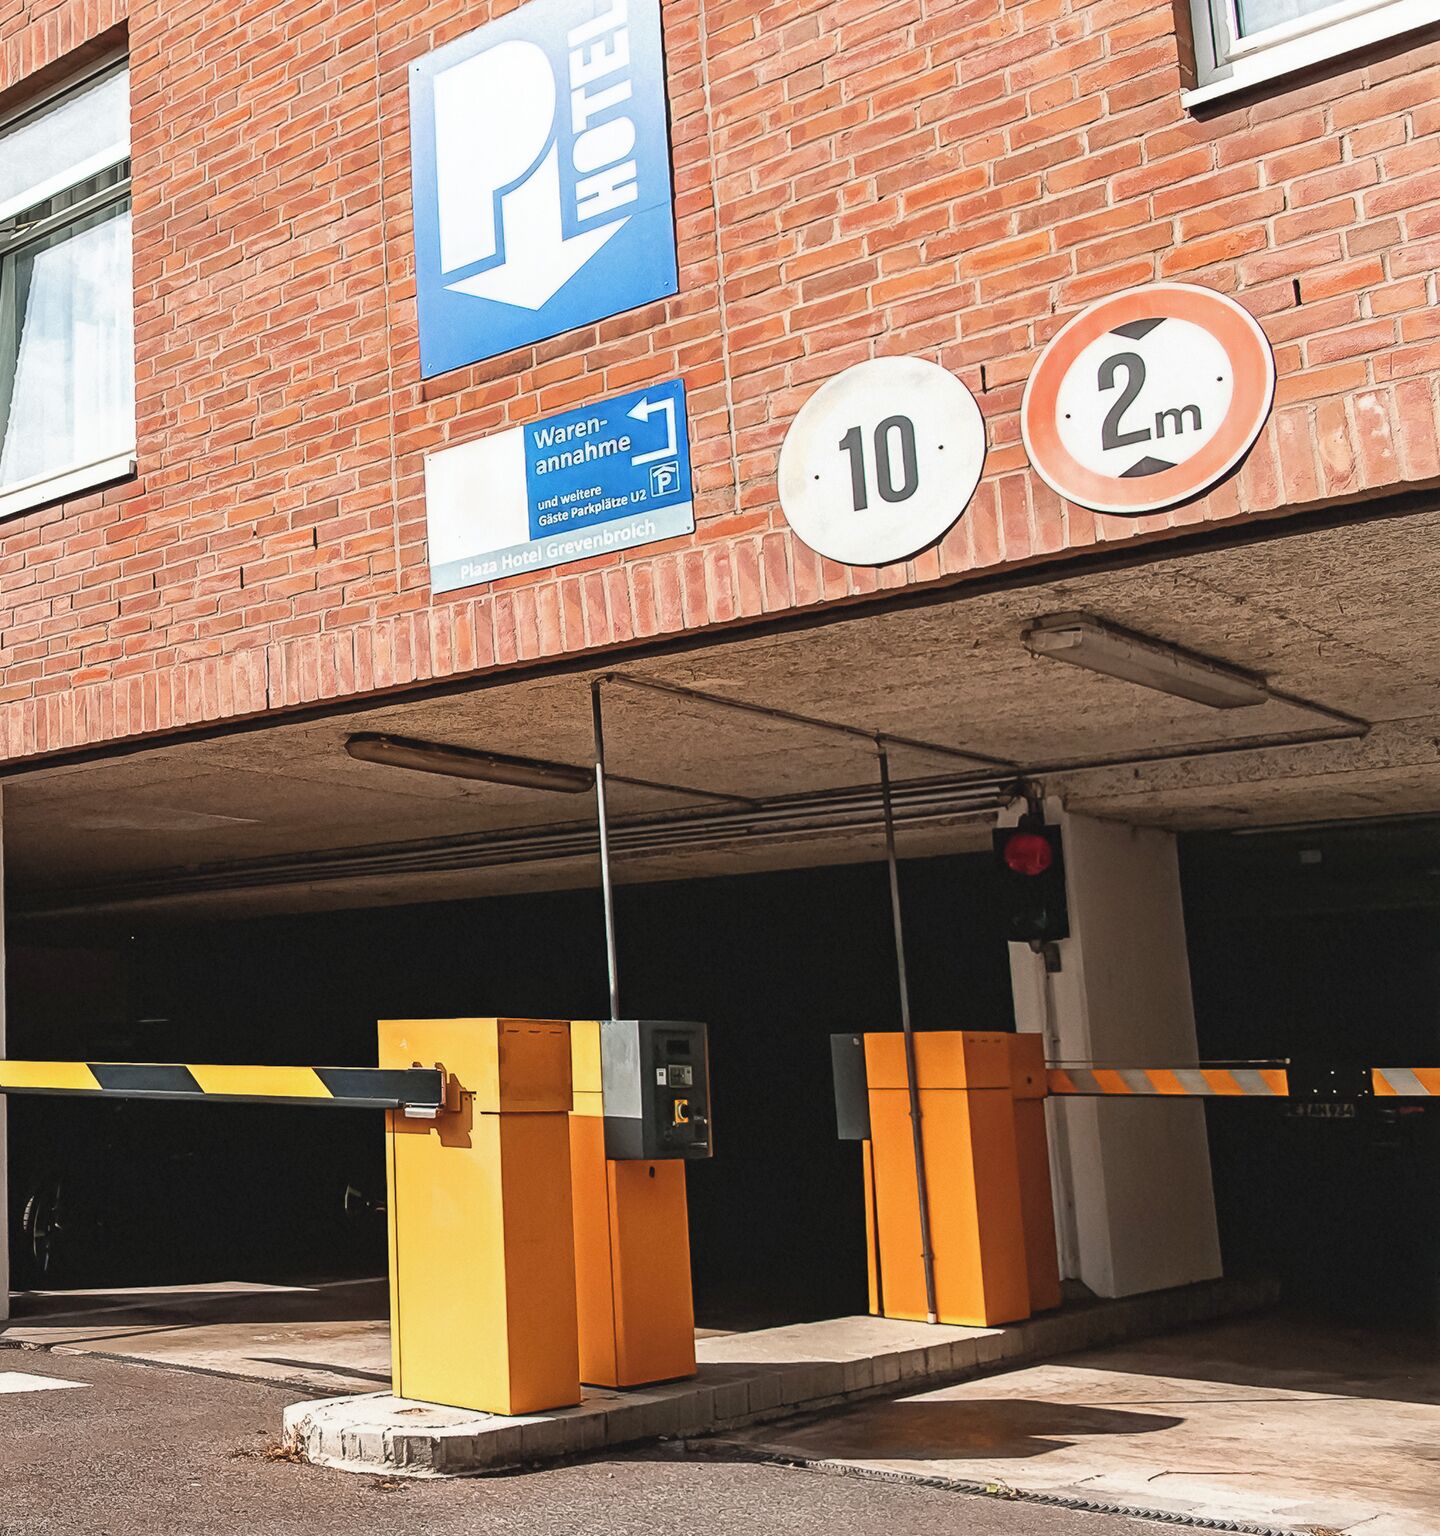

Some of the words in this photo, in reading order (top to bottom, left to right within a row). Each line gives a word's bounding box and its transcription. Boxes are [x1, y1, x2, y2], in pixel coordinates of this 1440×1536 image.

[567, 0, 638, 222] HOTEL
[534, 417, 608, 449] Waren-
[536, 435, 631, 475] annahme
[839, 414, 918, 512] 10
[538, 495, 558, 510] und
[560, 486, 602, 505] weitere
[539, 511, 568, 526] Gäste
[571, 496, 628, 518] Parkplätze
[630, 489, 647, 503] U2
[460, 561, 498, 581] Plaza
[502, 545, 542, 570] Hotel
[546, 519, 656, 559] Grevenbroich
